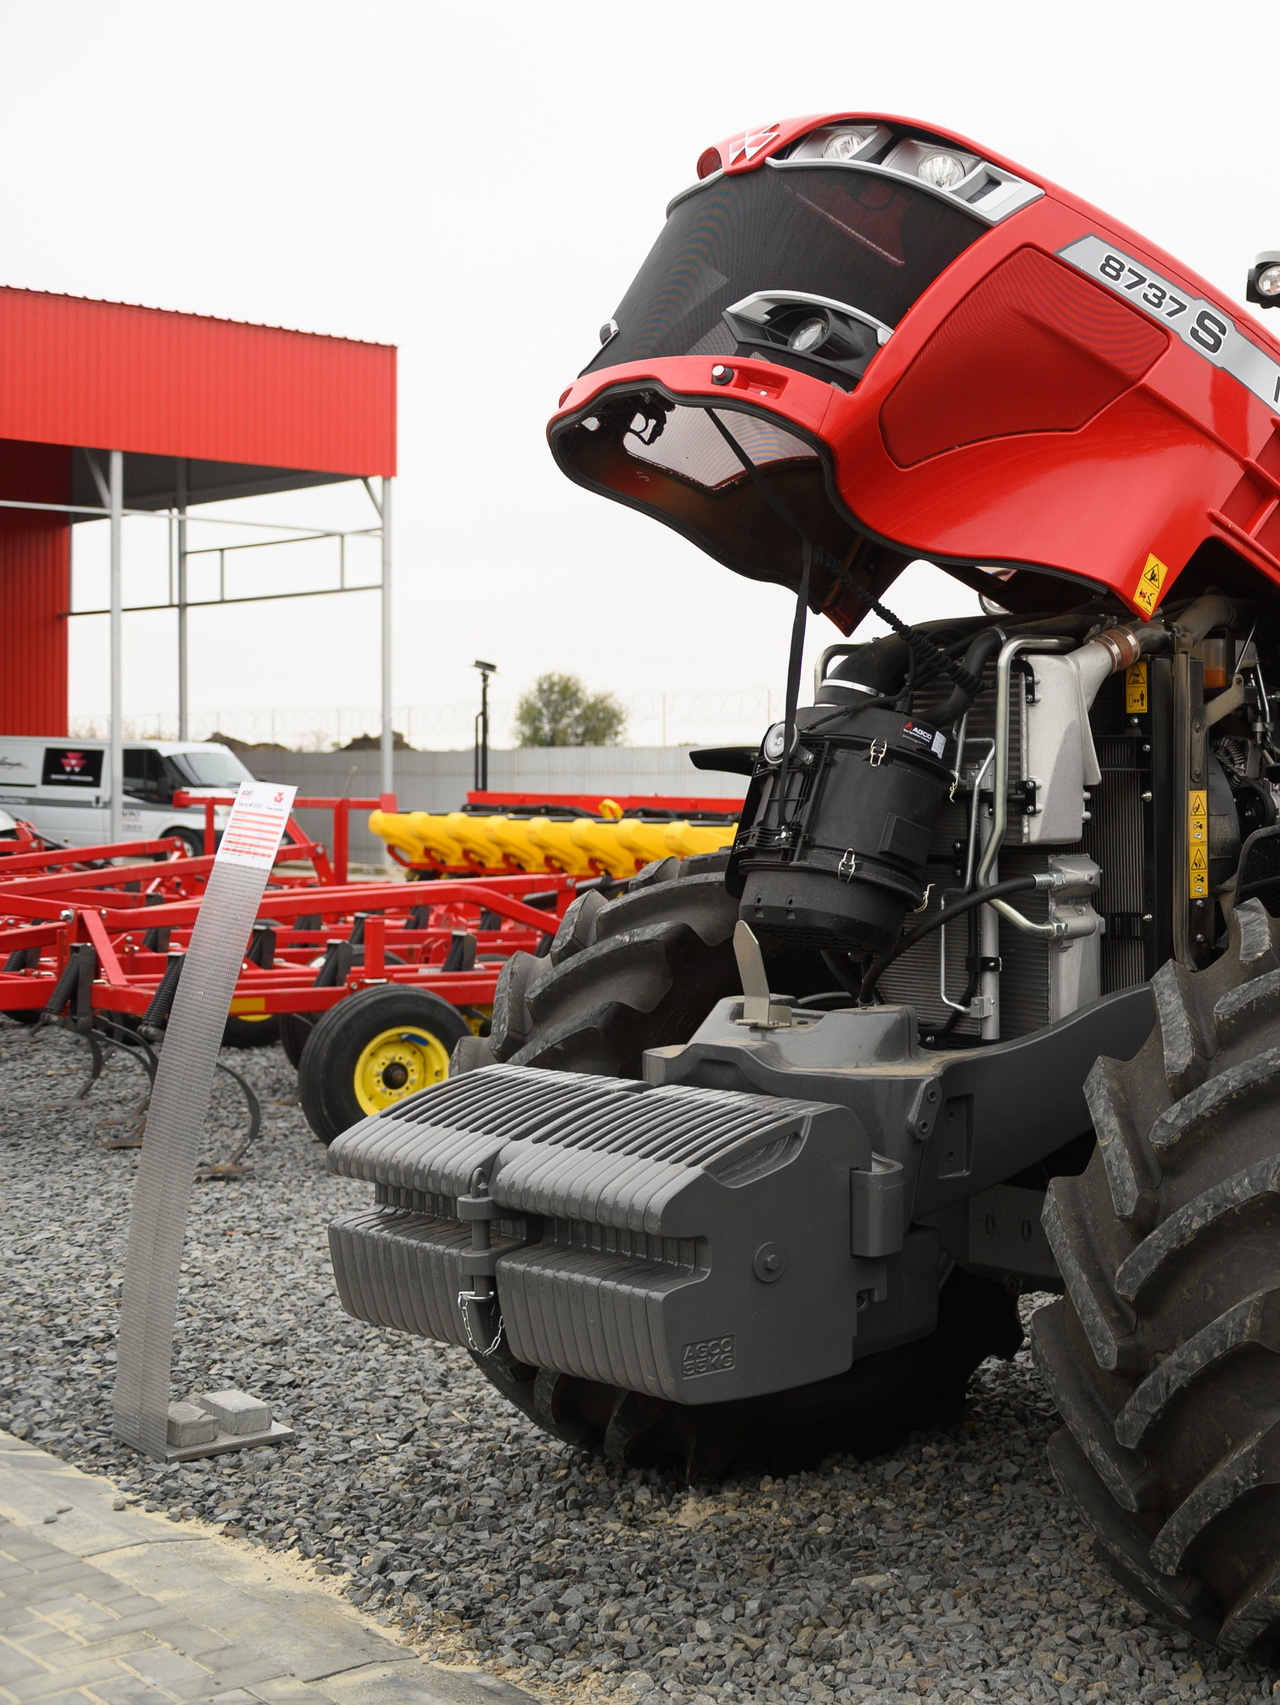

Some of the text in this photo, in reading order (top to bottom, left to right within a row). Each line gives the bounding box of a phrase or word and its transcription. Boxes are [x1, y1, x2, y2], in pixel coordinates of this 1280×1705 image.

[1099, 253, 1228, 355] 8737 S
[683, 1337, 733, 1361] AGCO
[683, 1352, 734, 1375] 55KG
